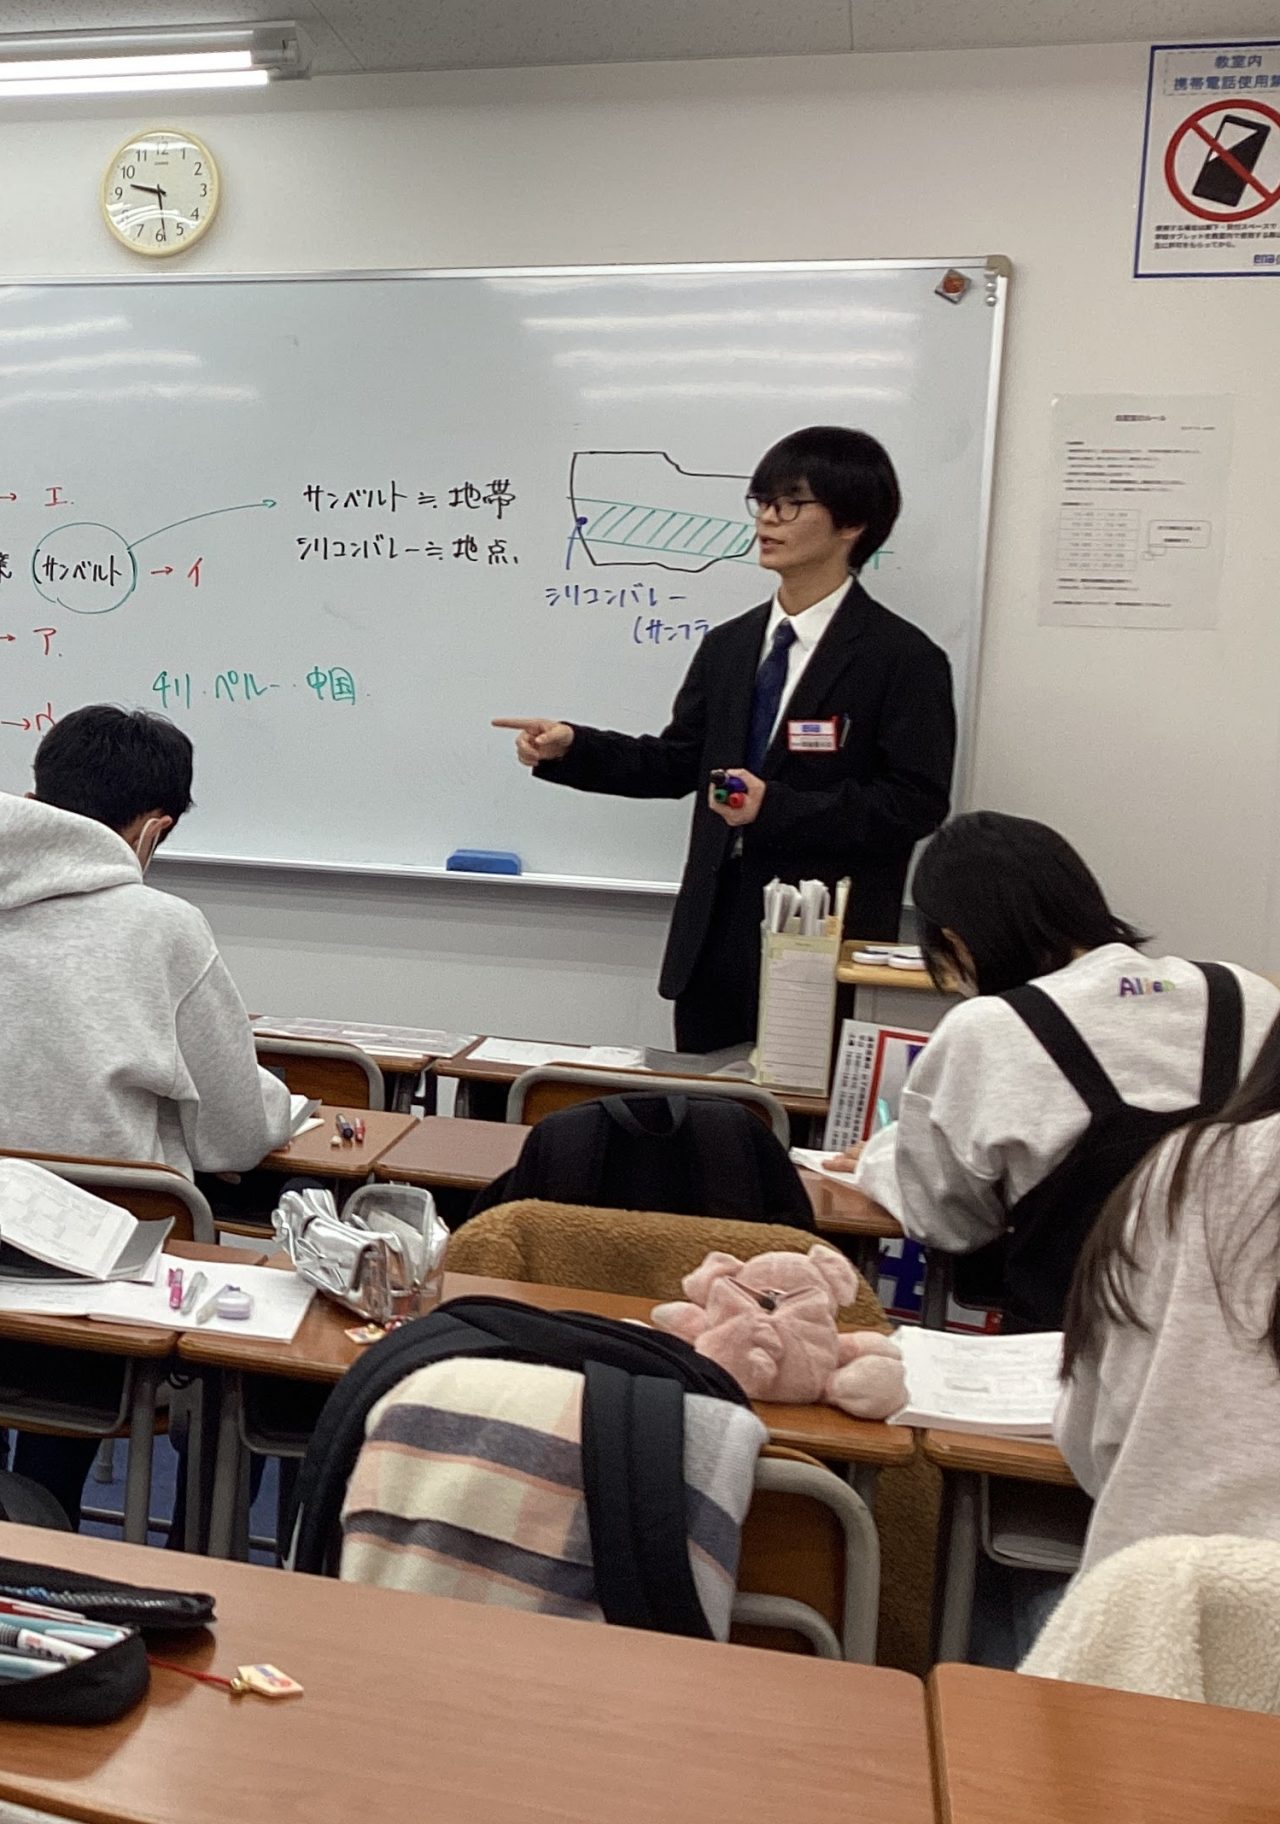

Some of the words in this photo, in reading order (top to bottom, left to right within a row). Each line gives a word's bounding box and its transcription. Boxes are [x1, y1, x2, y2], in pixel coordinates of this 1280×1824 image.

[1214, 55, 1262, 69] 教室内
[121, 165, 135, 179] 10
[194, 162, 202, 176] 2
[114, 187, 123, 200] 9
[200, 183, 207, 197] 3
[191, 207, 199, 220] 4
[136, 223, 144, 238] 7
[155, 228, 165, 242] 6
[176, 222, 184, 236] 5
[187, 557, 203, 587] イ
[545, 582, 687, 607] シリコンバレー
